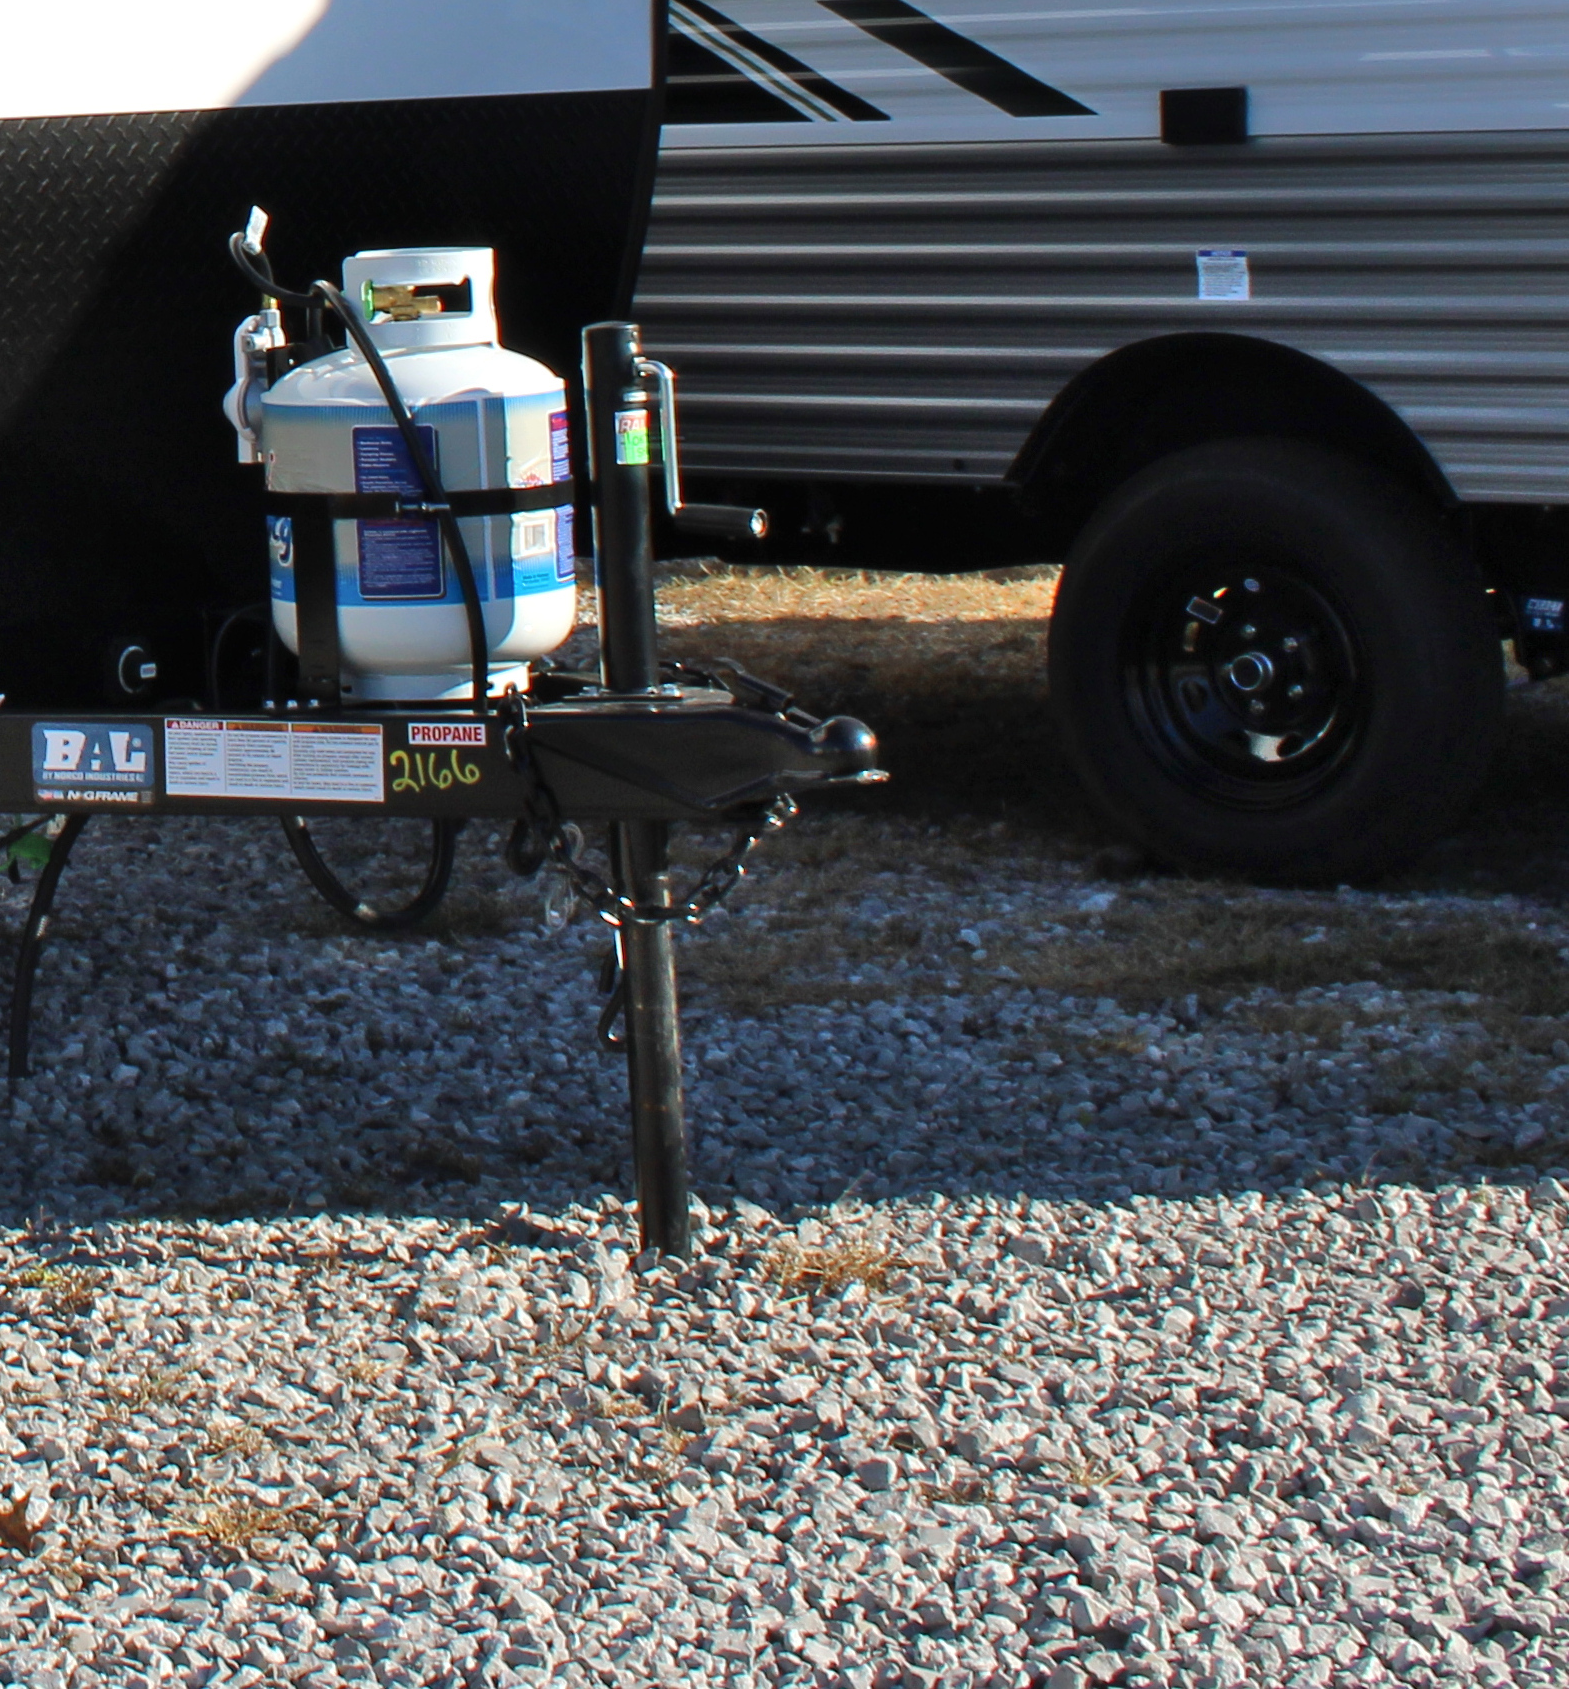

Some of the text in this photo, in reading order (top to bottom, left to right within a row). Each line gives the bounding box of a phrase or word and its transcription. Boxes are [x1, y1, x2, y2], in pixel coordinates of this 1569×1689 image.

[180, 720, 220, 730] DANGER
[410, 724, 483, 743] PROPANE
[43, 729, 147, 773] BAL
[84, 771, 135, 783] INDUSTRIES
[389, 749, 481, 794] 2166
